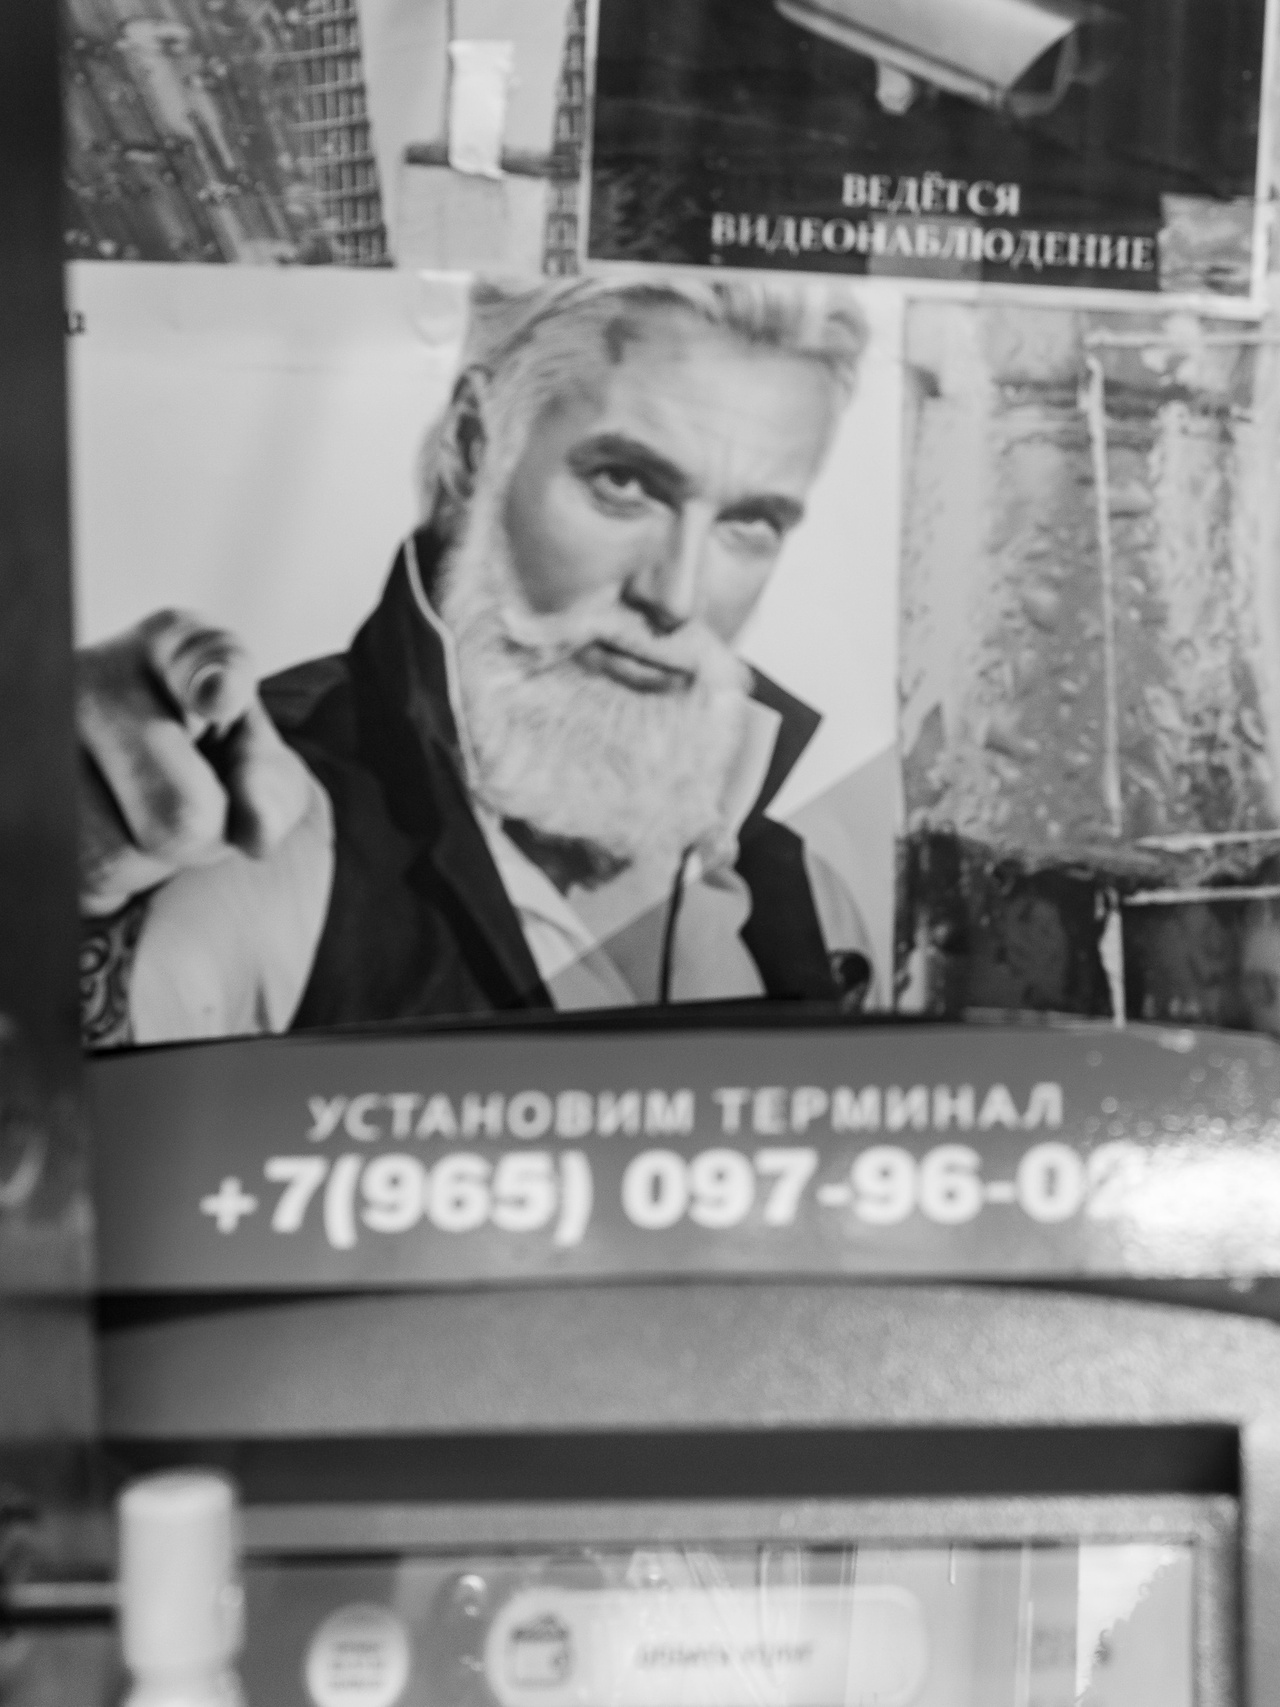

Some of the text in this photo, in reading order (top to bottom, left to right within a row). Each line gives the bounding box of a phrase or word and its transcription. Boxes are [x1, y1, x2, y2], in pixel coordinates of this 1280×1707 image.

[842, 171, 1020, 216] ВЕДЁТСЯ
[711, 211, 1156, 271] ВИДЕОНАБЛЮДЕНИЕ
[307, 1082, 1064, 1142] УСТАНОВИМ ТЕРМИНАЛ
[200, 1141, 1146, 1250] +7(965) 097-96-02
